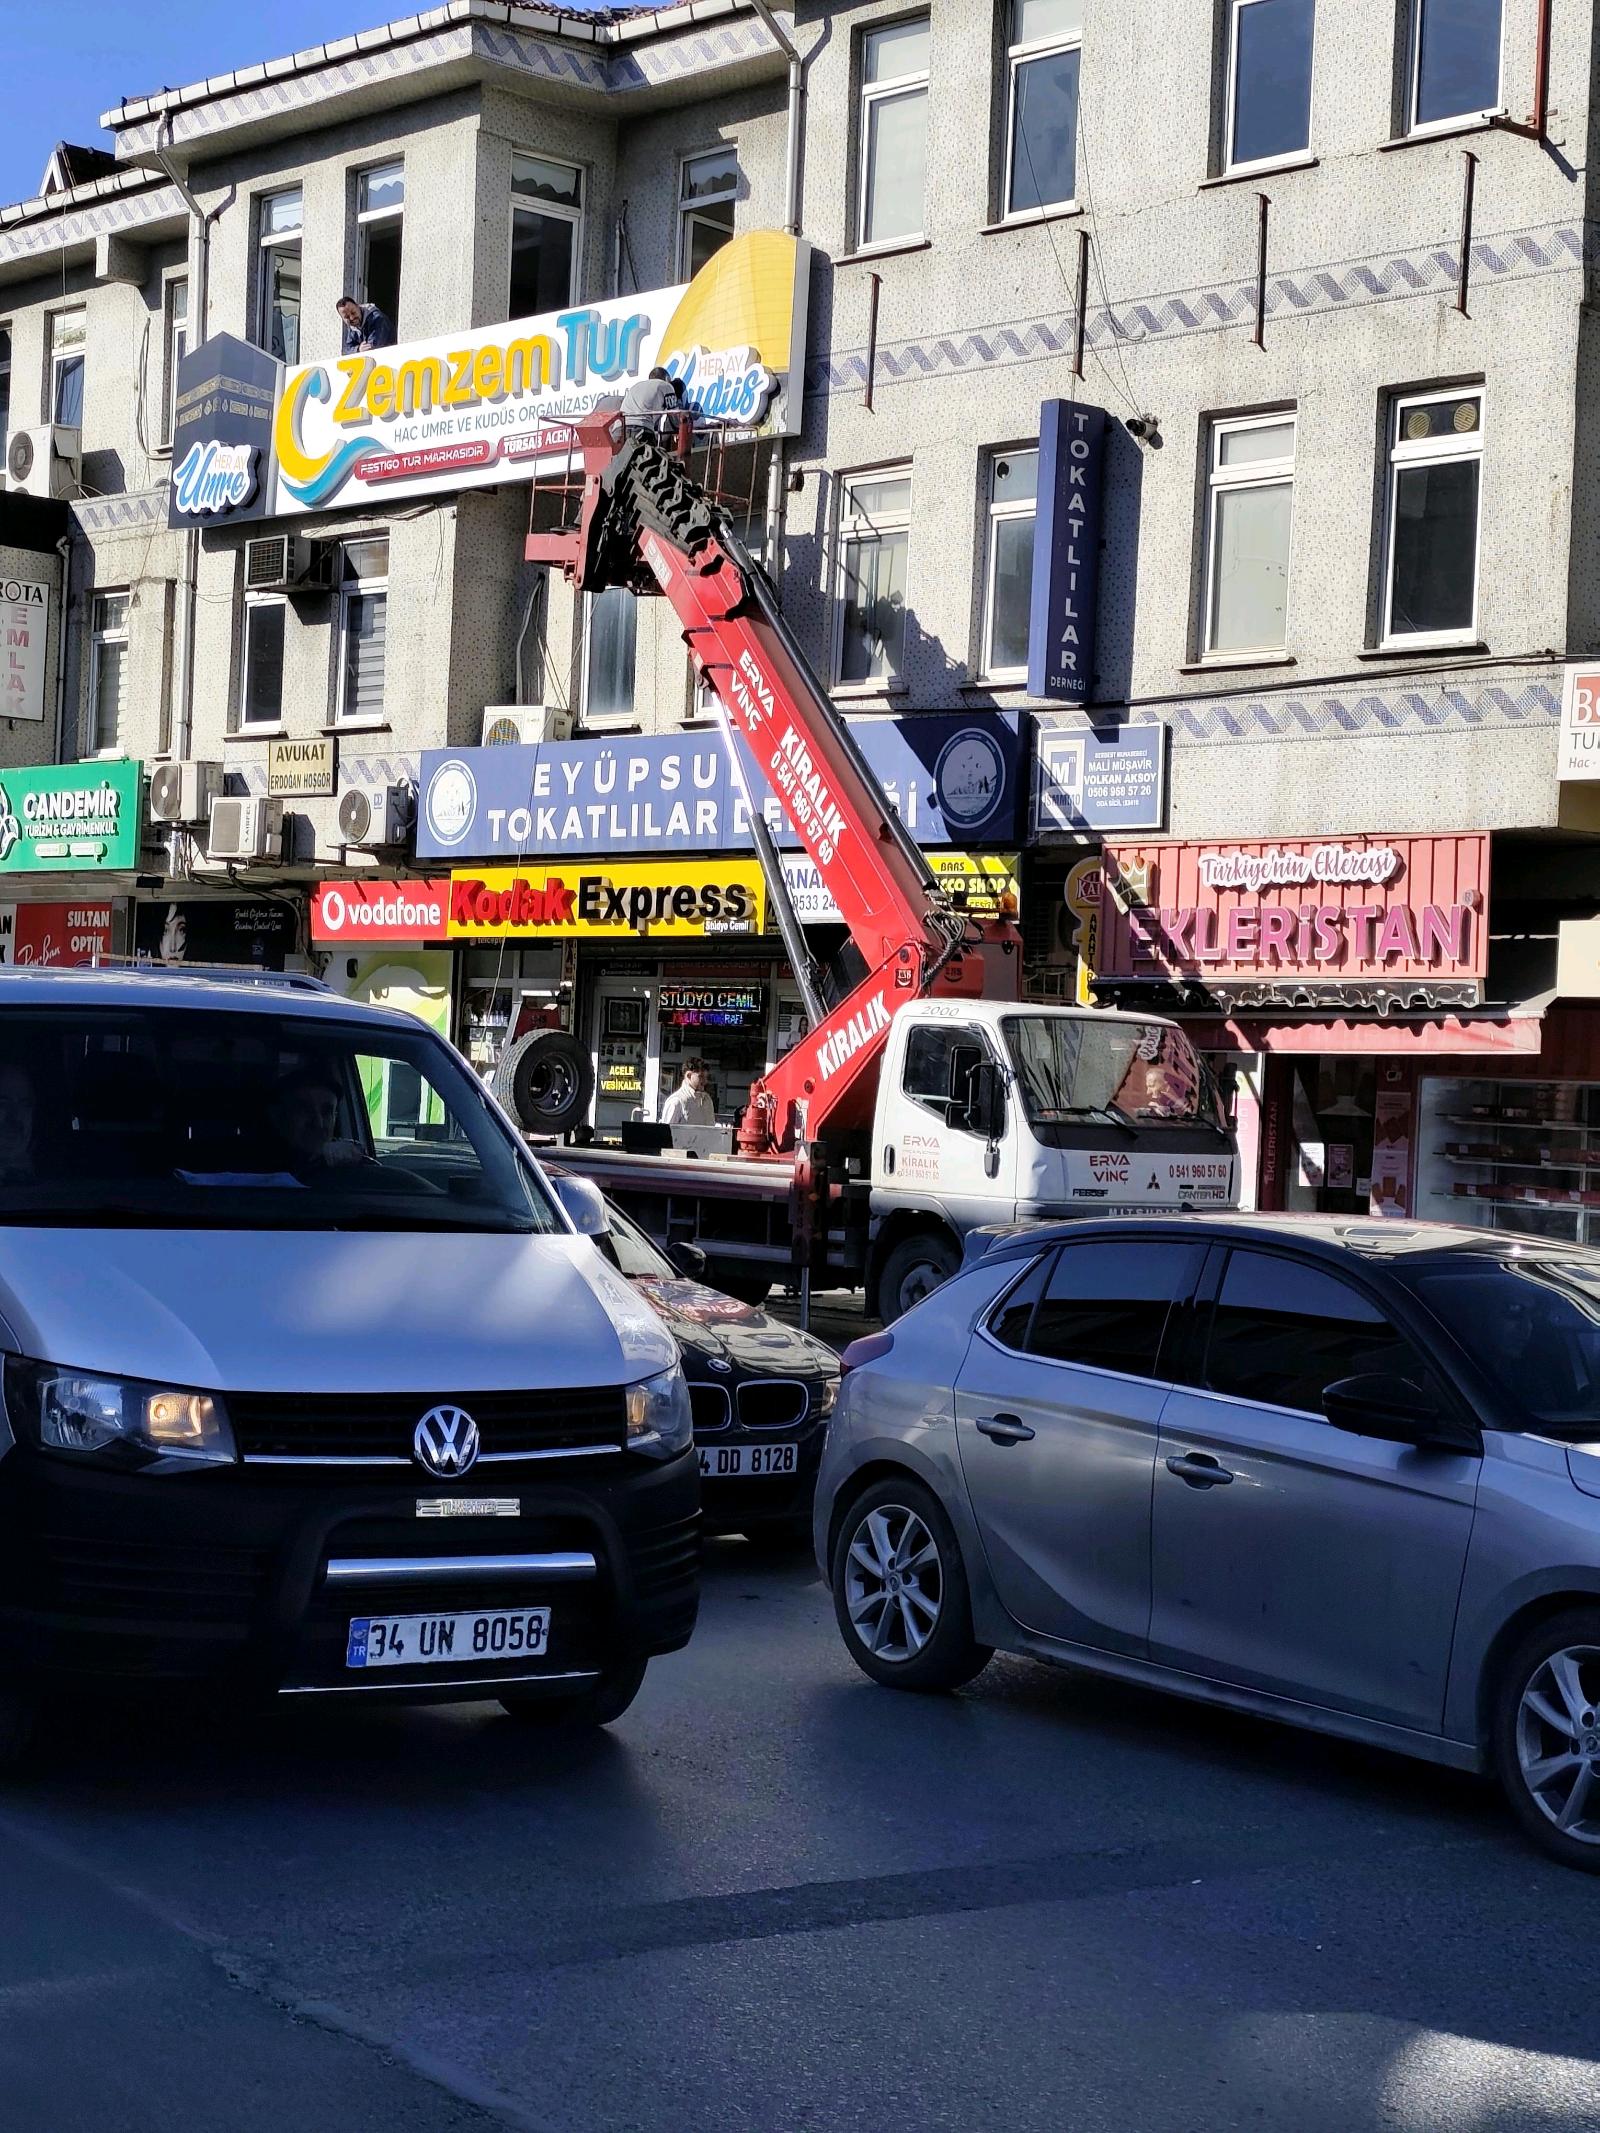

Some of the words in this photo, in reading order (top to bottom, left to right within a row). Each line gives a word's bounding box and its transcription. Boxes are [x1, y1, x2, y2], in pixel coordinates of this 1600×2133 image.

[332, 334, 551, 424] Zemzem
[556, 309, 650, 382] Tur
[699, 361, 722, 378] HER
[725, 353, 744, 373] AY
[394, 426, 418, 444] HAC
[421, 418, 454, 439] UMRE
[457, 415, 472, 432] VE
[475, 406, 515, 429] KUDÜS
[214, 454, 234, 469] HER
[234, 456, 249, 471] AY
[402, 454, 423, 468] TUR
[423, 445, 484, 465] MARKASIDIR
[176, 447, 246, 508] Umre
[1060, 412, 1090, 671] TOKATLILAR
[6, 607, 30, 714] EMLAK
[739, 648, 776, 719] ERVA
[731, 669, 763, 732] VİNÇ
[276, 743, 327, 763] AVUKAT
[1088, 759, 1110, 773] MALİ
[1112, 757, 1153, 773] MÜŞAVİR
[270, 769, 302, 790] ERDOĞAN
[779, 725, 848, 848] KİRALIK
[1084, 774, 1122, 785] VOLKAN
[1123, 772, 1157, 784] AKSOY
[1127, 785, 1139, 796] 57
[23, 780, 118, 820] CANDEMİR
[487, 799, 719, 842] TOKATLILAR
[776, 762, 797, 797] 541
[792, 789, 812, 824] 960
[806, 817, 823, 844] 57
[818, 838, 834, 866] 60
[1202, 856, 1310, 886] Türkiye'nin
[968, 877, 1007, 894] SHOP
[347, 896, 441, 926] vodafone
[450, 877, 575, 924] Kodak
[578, 875, 748, 930] Express
[67, 910, 111, 928] SULTAN
[70, 931, 105, 955] OPTİK
[1129, 903, 1466, 962] EKLERİSTAN
[920, 1006, 960, 1016] 2000
[815, 990, 892, 1081] KİRALIK
[609, 1065, 635, 1076] ACELE
[600, 1078, 642, 1091] VESİKALIK
[903, 1135, 940, 1148] ERVA
[901, 1154, 940, 1170] KİRALIK
[1089, 1154, 1131, 1167] ERVA
[1169, 1165, 1174, 1178] 0
[1175, 1165, 1190, 1179] 541
[1191, 1165, 1206, 1179] 960
[1206, 1165, 1218, 1178] 57
[1217, 1164, 1227, 1179] 60
[1093, 1168, 1129, 1185] VİNÇ
[1177, 1190, 1212, 1200] CANTER
[1211, 1190, 1226, 1200] HD
[718, 1448, 741, 1474] DD
[751, 1446, 794, 1473] 8128
[369, 1622, 405, 1658] 34
[418, 1620, 456, 1656] UN
[472, 1614, 545, 1654] 8058
[352, 1644, 367, 1657] TR
